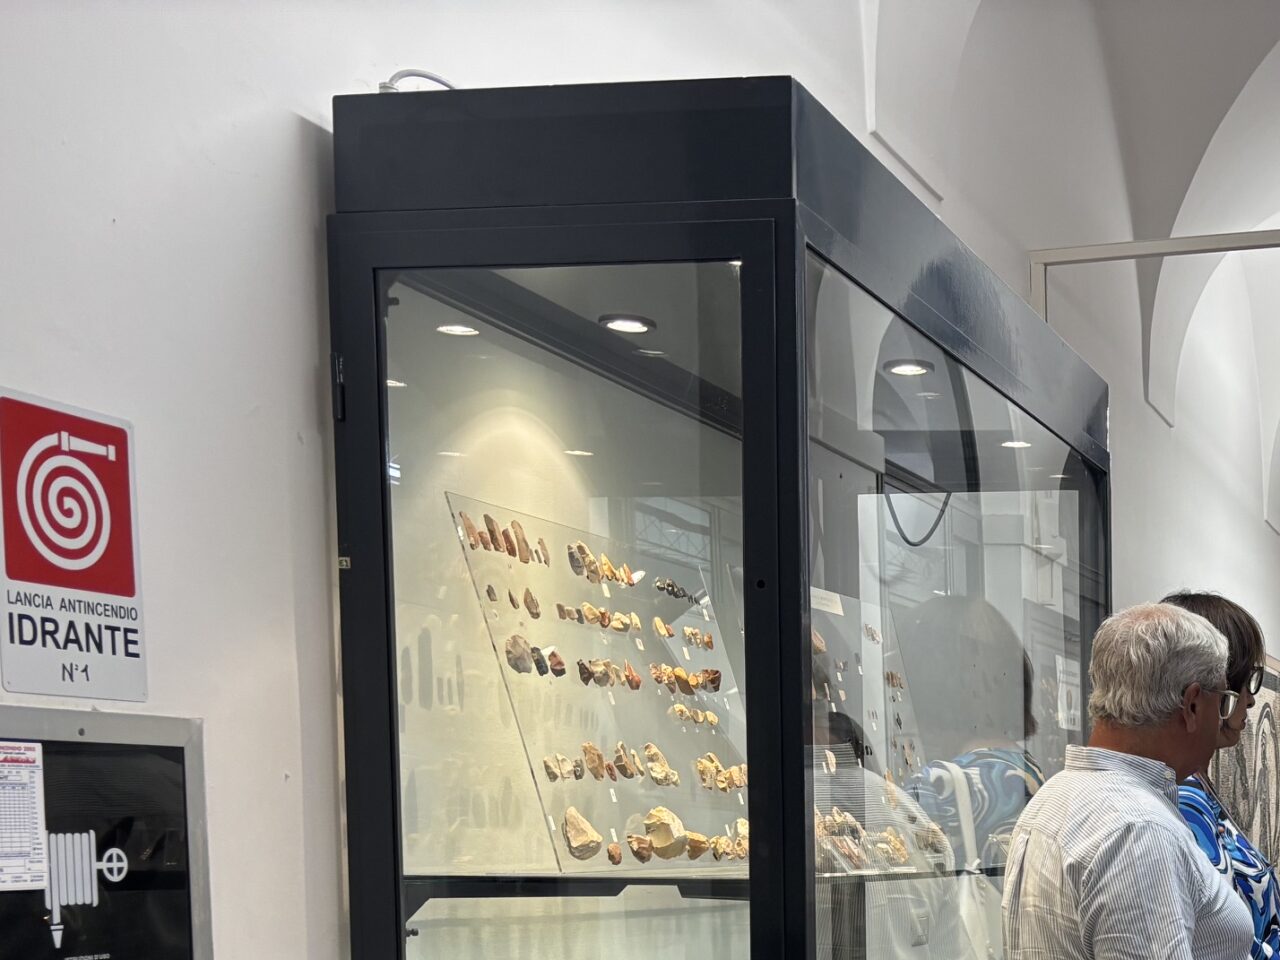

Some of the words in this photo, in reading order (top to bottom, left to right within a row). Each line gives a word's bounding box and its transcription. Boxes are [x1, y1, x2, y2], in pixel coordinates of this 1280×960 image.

[7, 589, 53, 610] LANCIA
[59, 597, 138, 621] ANTINCENDIO
[8, 611, 140, 658] IDRANTE
